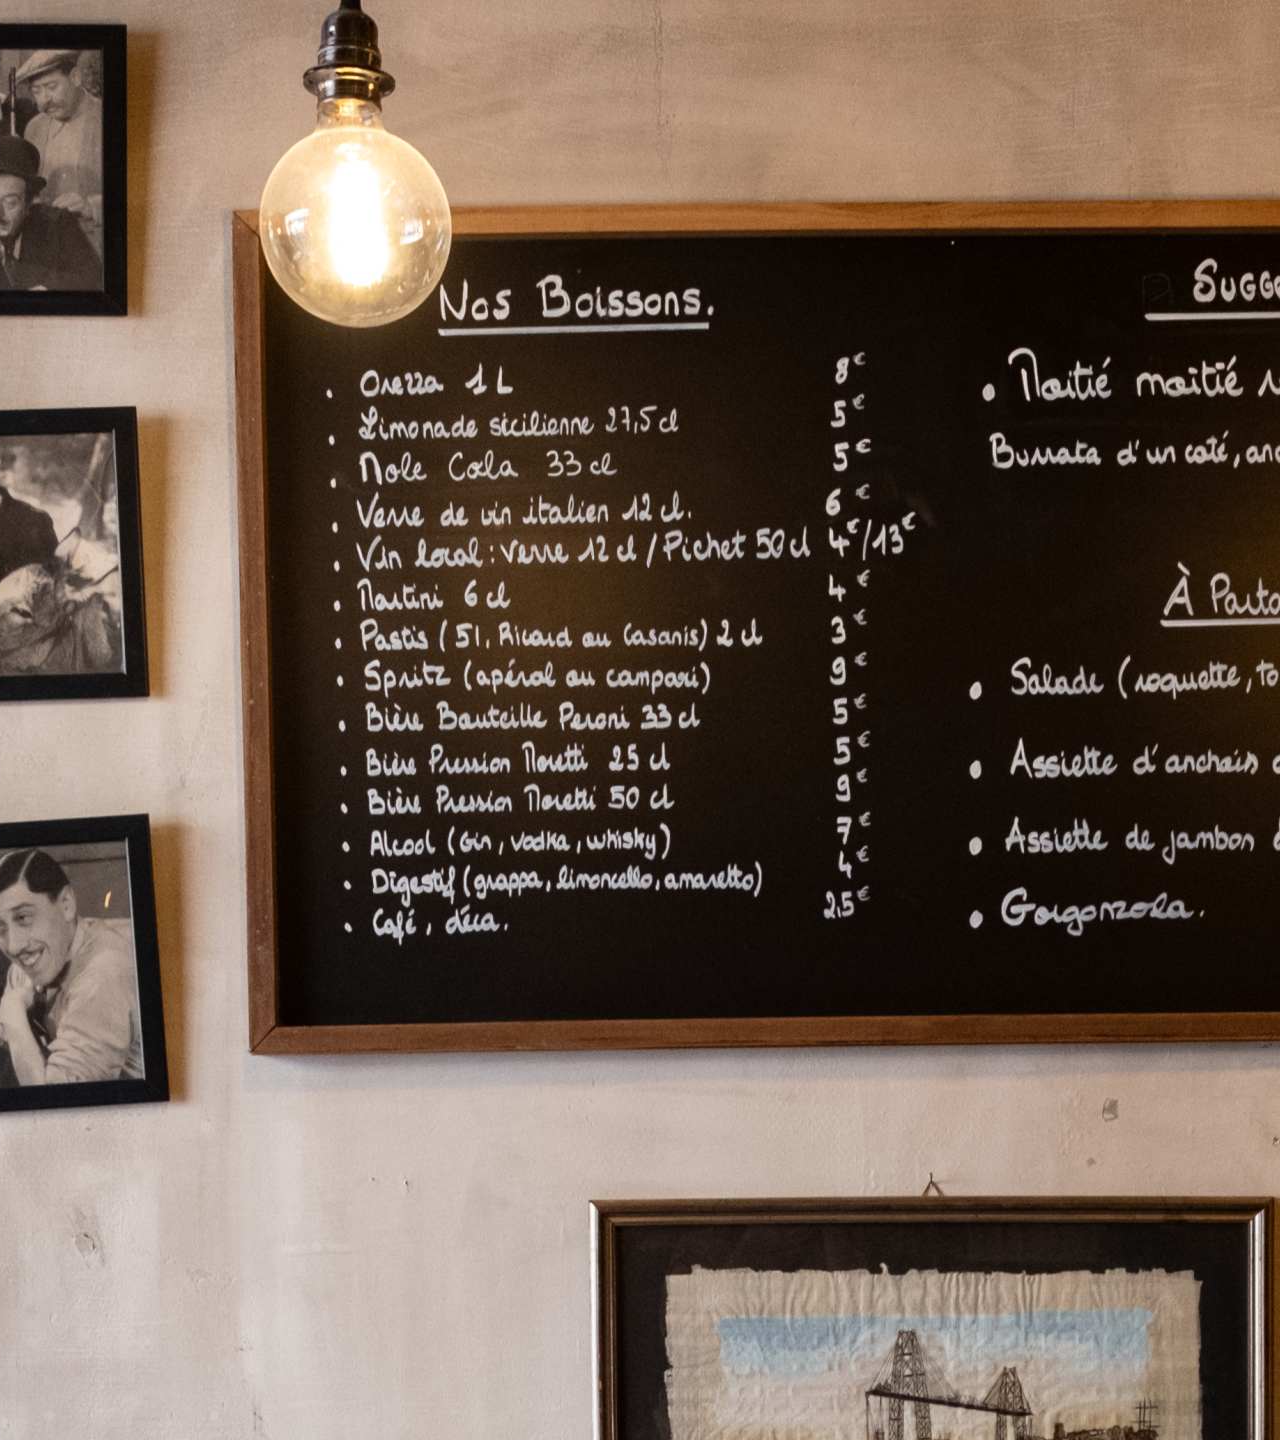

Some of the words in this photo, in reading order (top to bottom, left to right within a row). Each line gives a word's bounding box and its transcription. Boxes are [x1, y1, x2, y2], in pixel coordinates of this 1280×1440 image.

[439, 278, 512, 322] Nos
[535, 273, 715, 319] Boissons.
[464, 362, 488, 396] 1
[496, 365, 514, 395] L
[1135, 354, 1244, 398] moitié
[357, 404, 479, 441] Limonade
[488, 409, 595, 438] sicilienne
[604, 404, 658, 435] 27,5
[658, 407, 680, 434] cl
[448, 449, 519, 482] Cola
[545, 449, 583, 478] 33
[589, 452, 618, 476] cl
[988, 431, 1103, 470] Burrata
[355, 491, 425, 529] Verre
[439, 501, 470, 528] de
[480, 500, 512, 527] vin
[521, 493, 609, 526] italien
[621, 492, 653, 522] 12
[355, 534, 403, 573] Vin
[577, 534, 610, 563] 12
[616, 533, 638, 563] cl
[662, 529, 747, 562] Pichet
[755, 526, 786, 560] 50
[789, 525, 812, 559] cl
[356, 577, 444, 612] Martini
[463, 578, 479, 608] 6
[485, 580, 512, 610] cl
[1161, 561, 1196, 617] À
[359, 617, 429, 652] Pastis
[497, 620, 573, 649] Ricard
[715, 618, 734, 648] 2
[740, 617, 764, 648] cl
[363, 658, 452, 699] Spritz
[1010, 656, 1105, 696] Salade
[364, 701, 425, 733] Bière
[558, 700, 631, 732] Peroni
[639, 702, 673, 731] 33
[677, 701, 701, 730] cl
[365, 747, 417, 777] Bière
[428, 742, 511, 775] Pression
[521, 740, 589, 774] Moretti
[608, 743, 640, 772] 25
[648, 741, 671, 772] cl
[1009, 736, 1119, 779] Assiette
[366, 786, 422, 816] Bière
[435, 783, 513, 815] Pression
[523, 782, 597, 813] Moretti
[607, 784, 641, 810] 50
[649, 783, 676, 810] cl
[369, 828, 437, 858] Alcool
[1004, 815, 1109, 855] Assiette
[1124, 823, 1156, 852] de
[1161, 823, 1255, 866] jambon
[370, 864, 456, 909] Digestif
